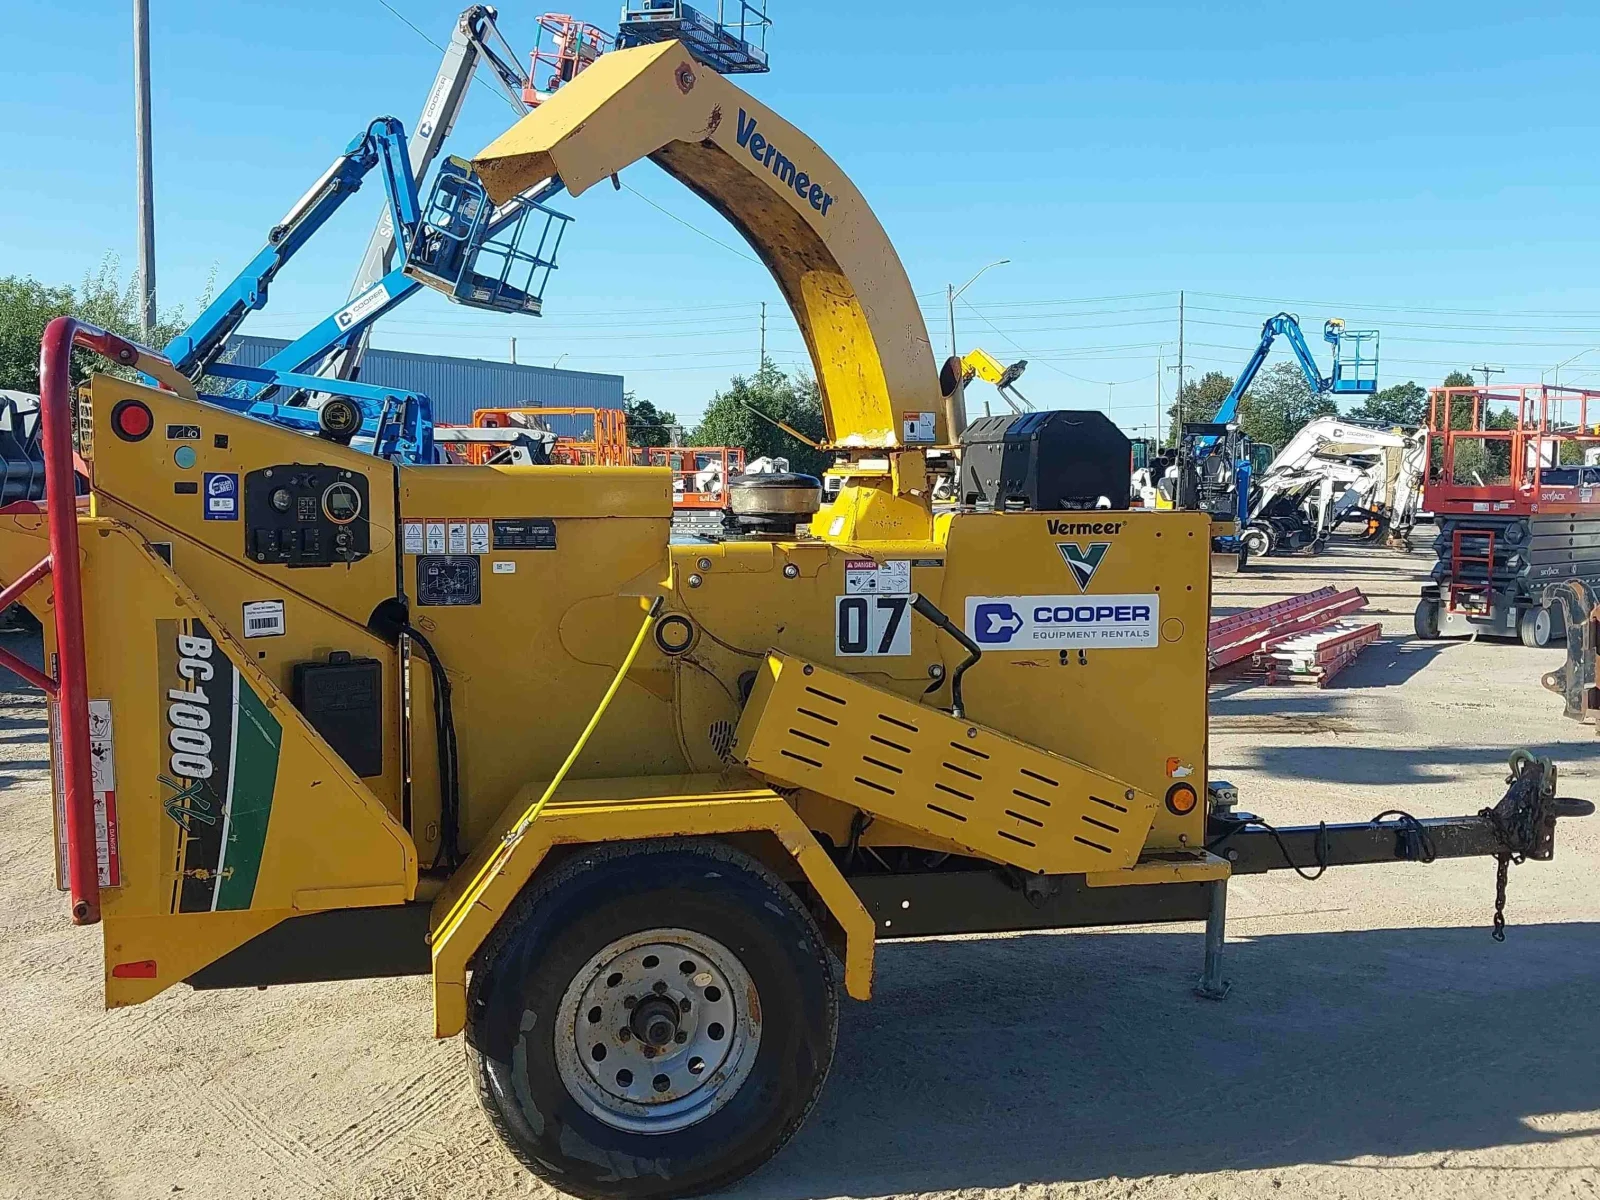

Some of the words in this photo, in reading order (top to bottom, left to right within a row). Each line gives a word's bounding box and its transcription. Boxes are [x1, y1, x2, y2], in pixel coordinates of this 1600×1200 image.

[427, 77, 447, 117] COOPER
[736, 107, 833, 217] Vermeer
[352, 288, 383, 312] COOPER
[1542, 491, 1565, 502] SKYJACK
[839, 597, 908, 653] 07
[1033, 606, 1151, 623] COOPER
[1033, 631, 1097, 640] EQUIPMENT
[1101, 630, 1150, 638] RENTALS
